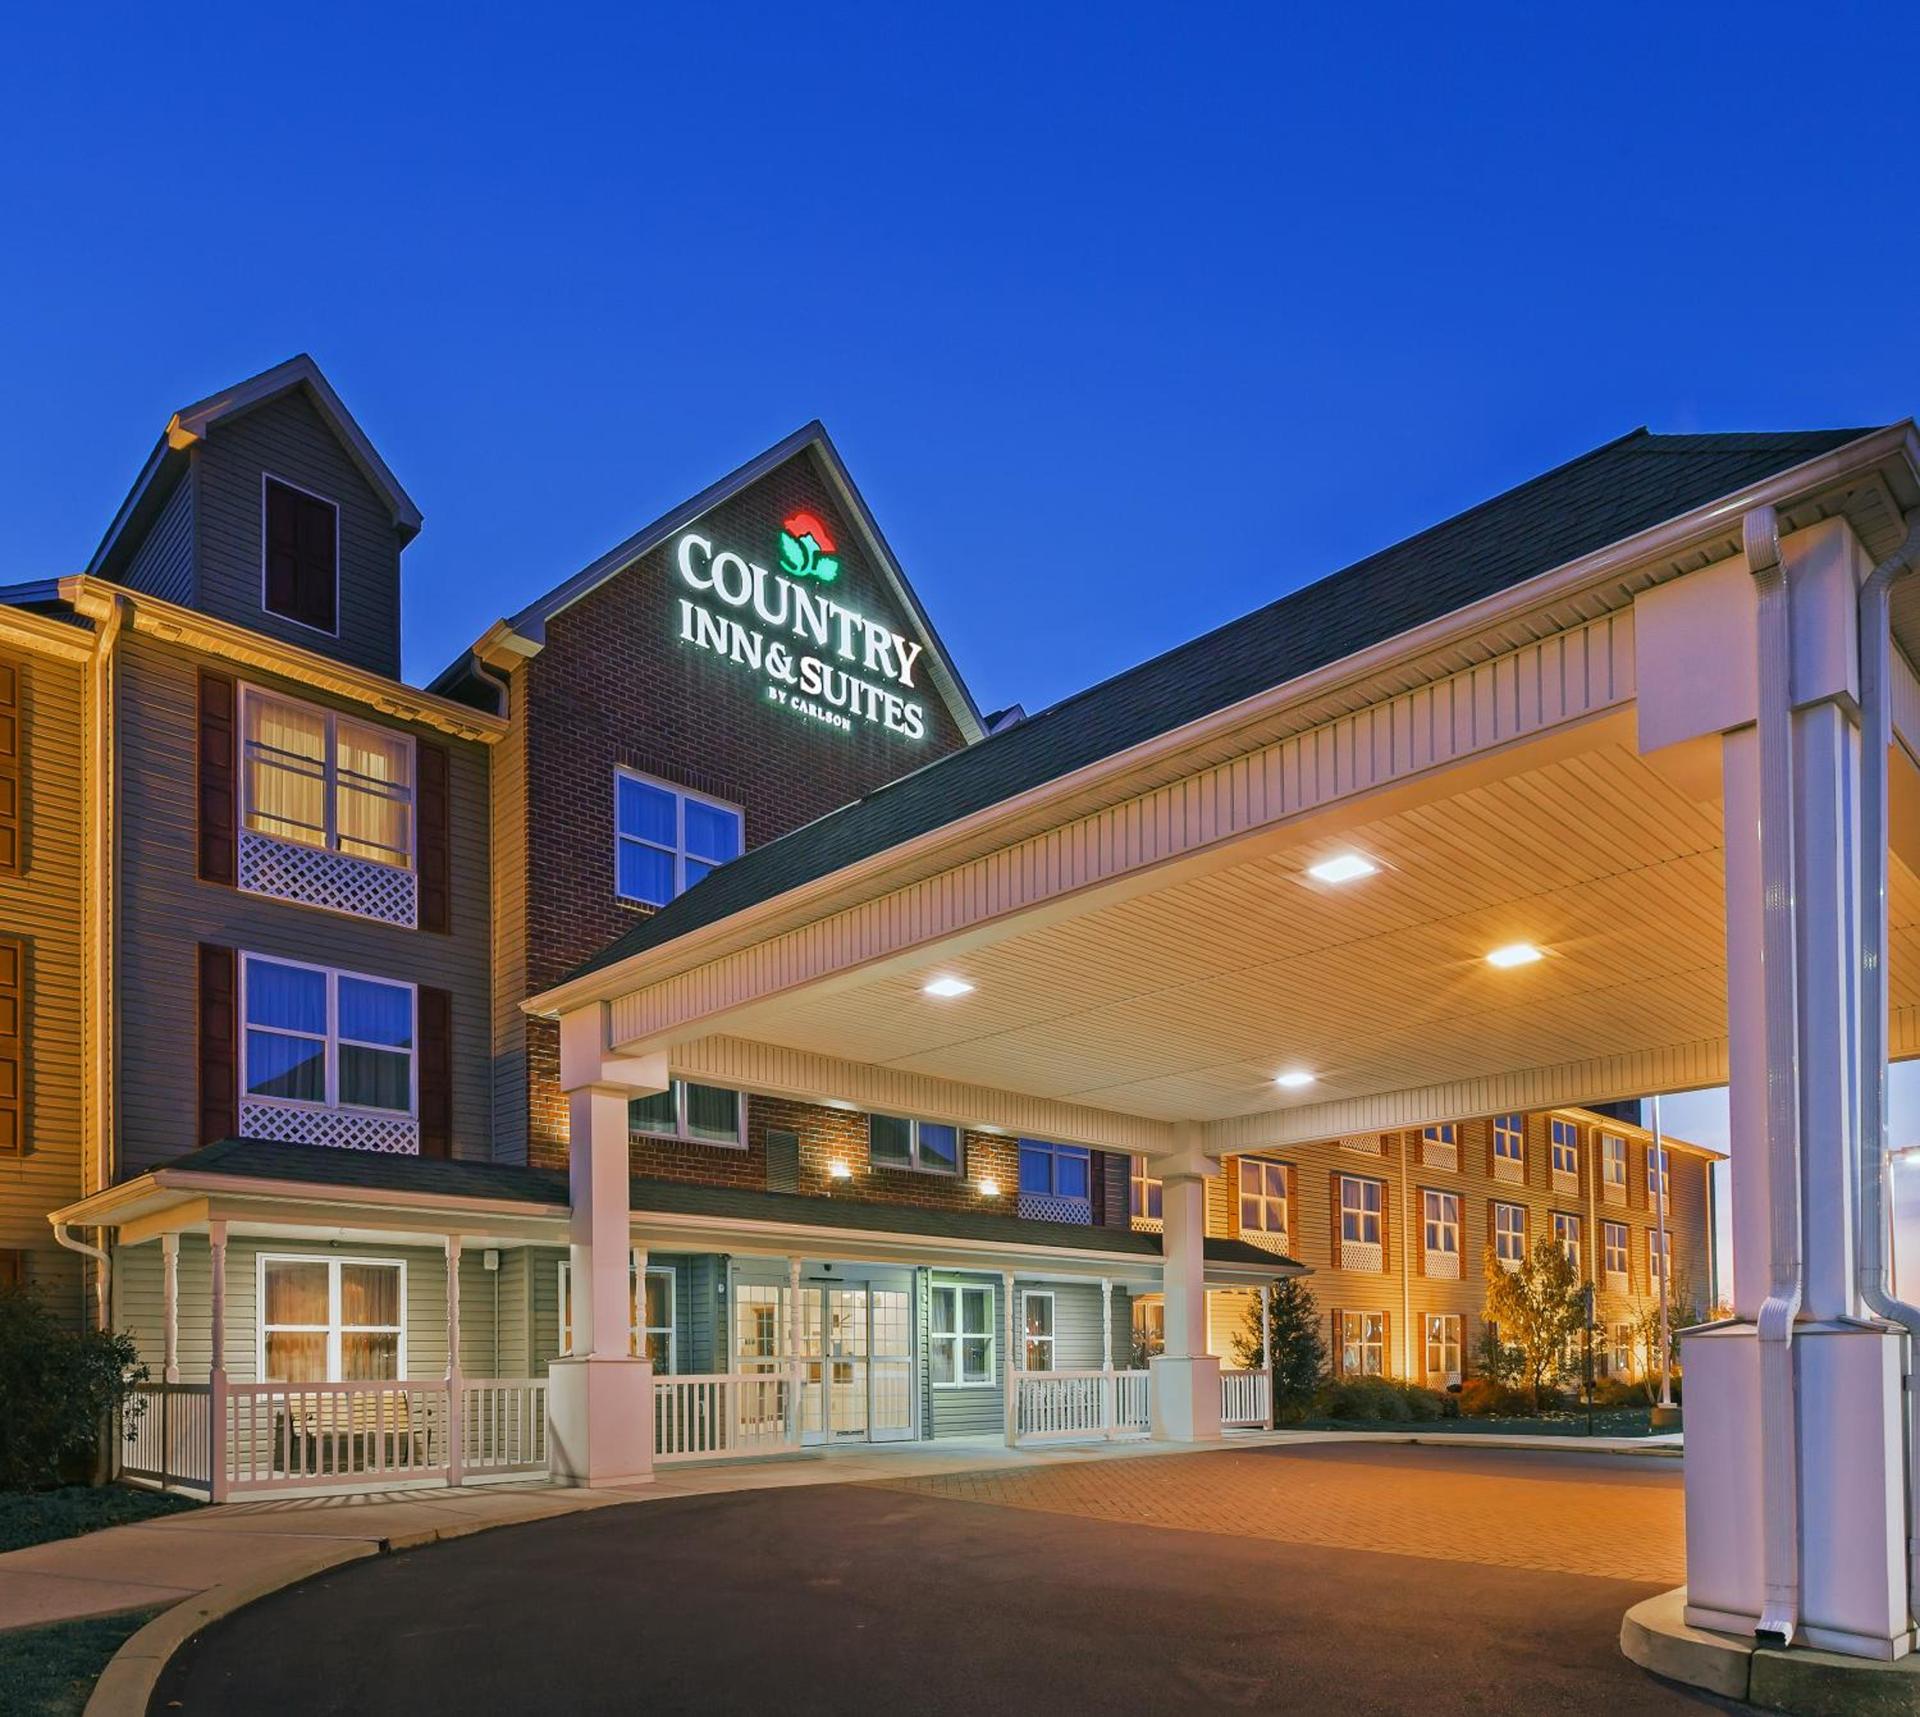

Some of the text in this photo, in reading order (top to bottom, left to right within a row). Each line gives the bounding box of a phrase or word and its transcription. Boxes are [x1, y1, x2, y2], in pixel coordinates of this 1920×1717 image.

[678, 534, 922, 688] COUNTRY
[768, 686, 850, 731] BY CARLSON
